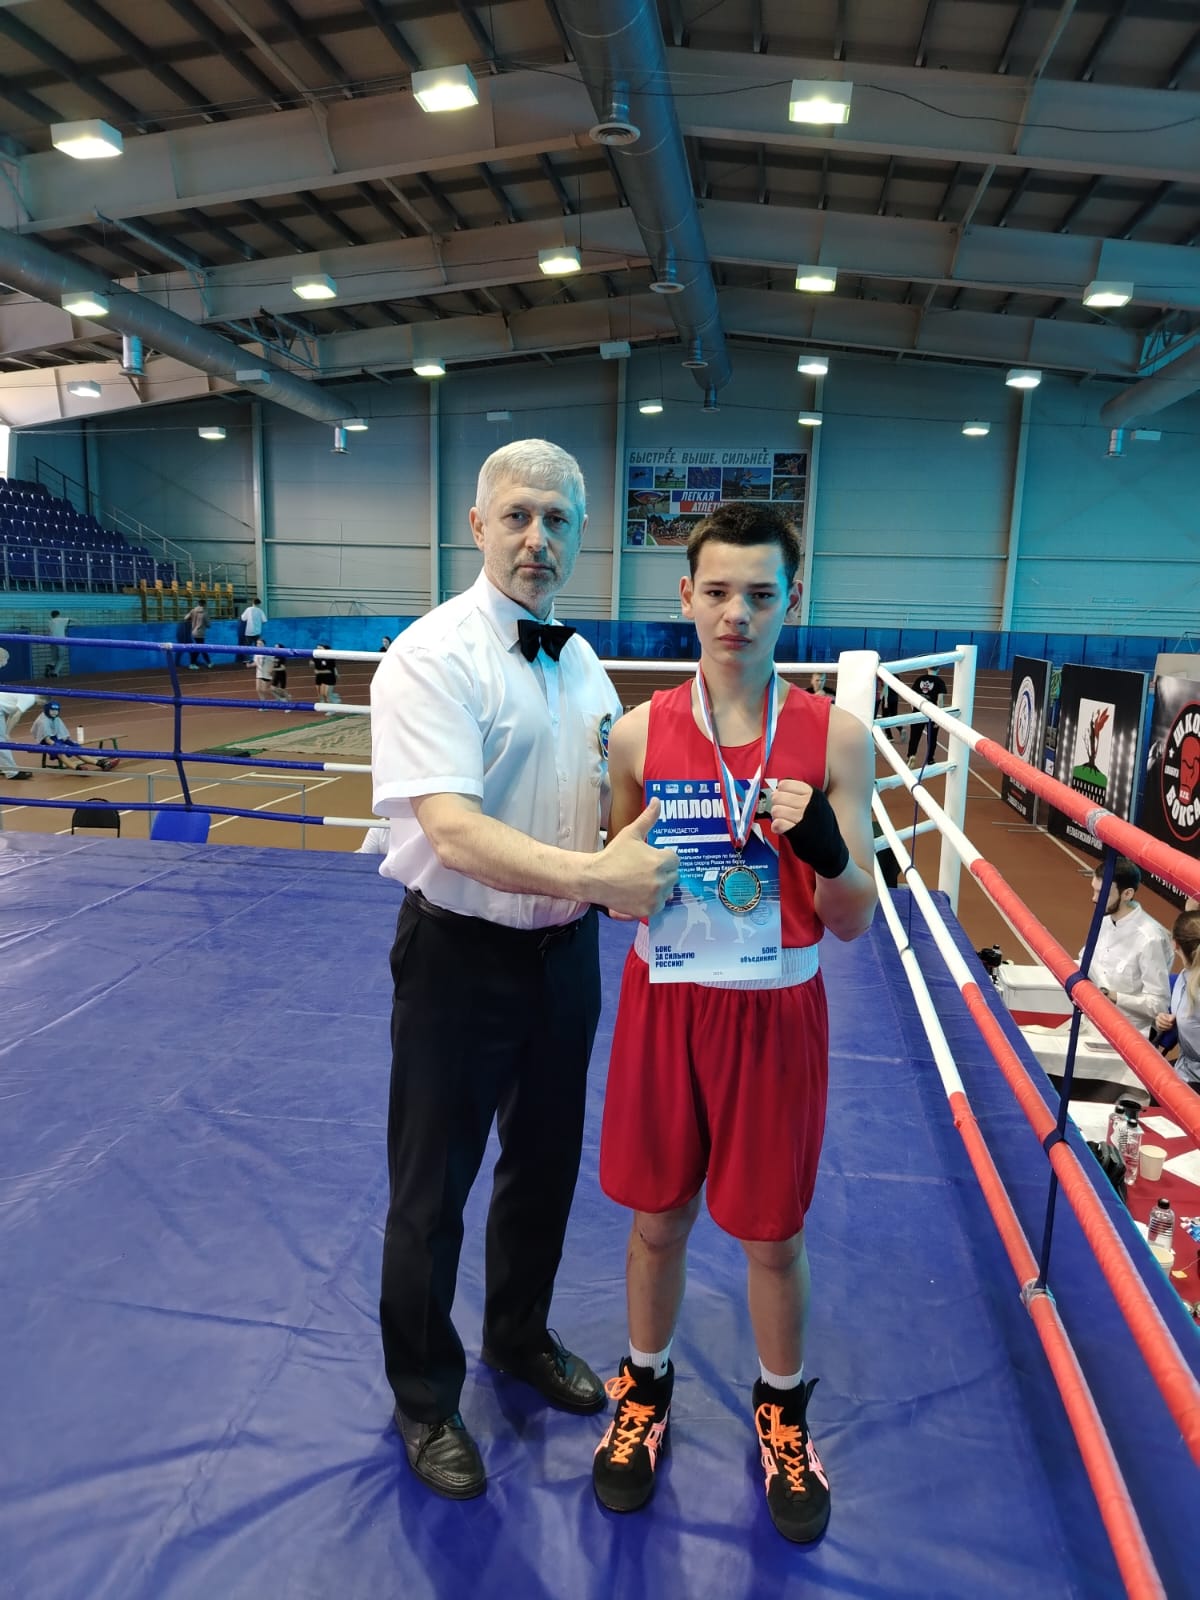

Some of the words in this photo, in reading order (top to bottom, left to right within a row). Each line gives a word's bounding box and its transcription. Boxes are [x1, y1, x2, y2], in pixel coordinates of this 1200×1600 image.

[682, 452, 718, 464] ВЫШЕ.
[722, 453, 772, 465] СИЛЬНЕЕ.
[681, 491, 715, 501] ЛЕГКАЯ
[1173, 712, 1200, 748] ШКО
[664, 952, 695, 960] СИЛЬНУЮ
